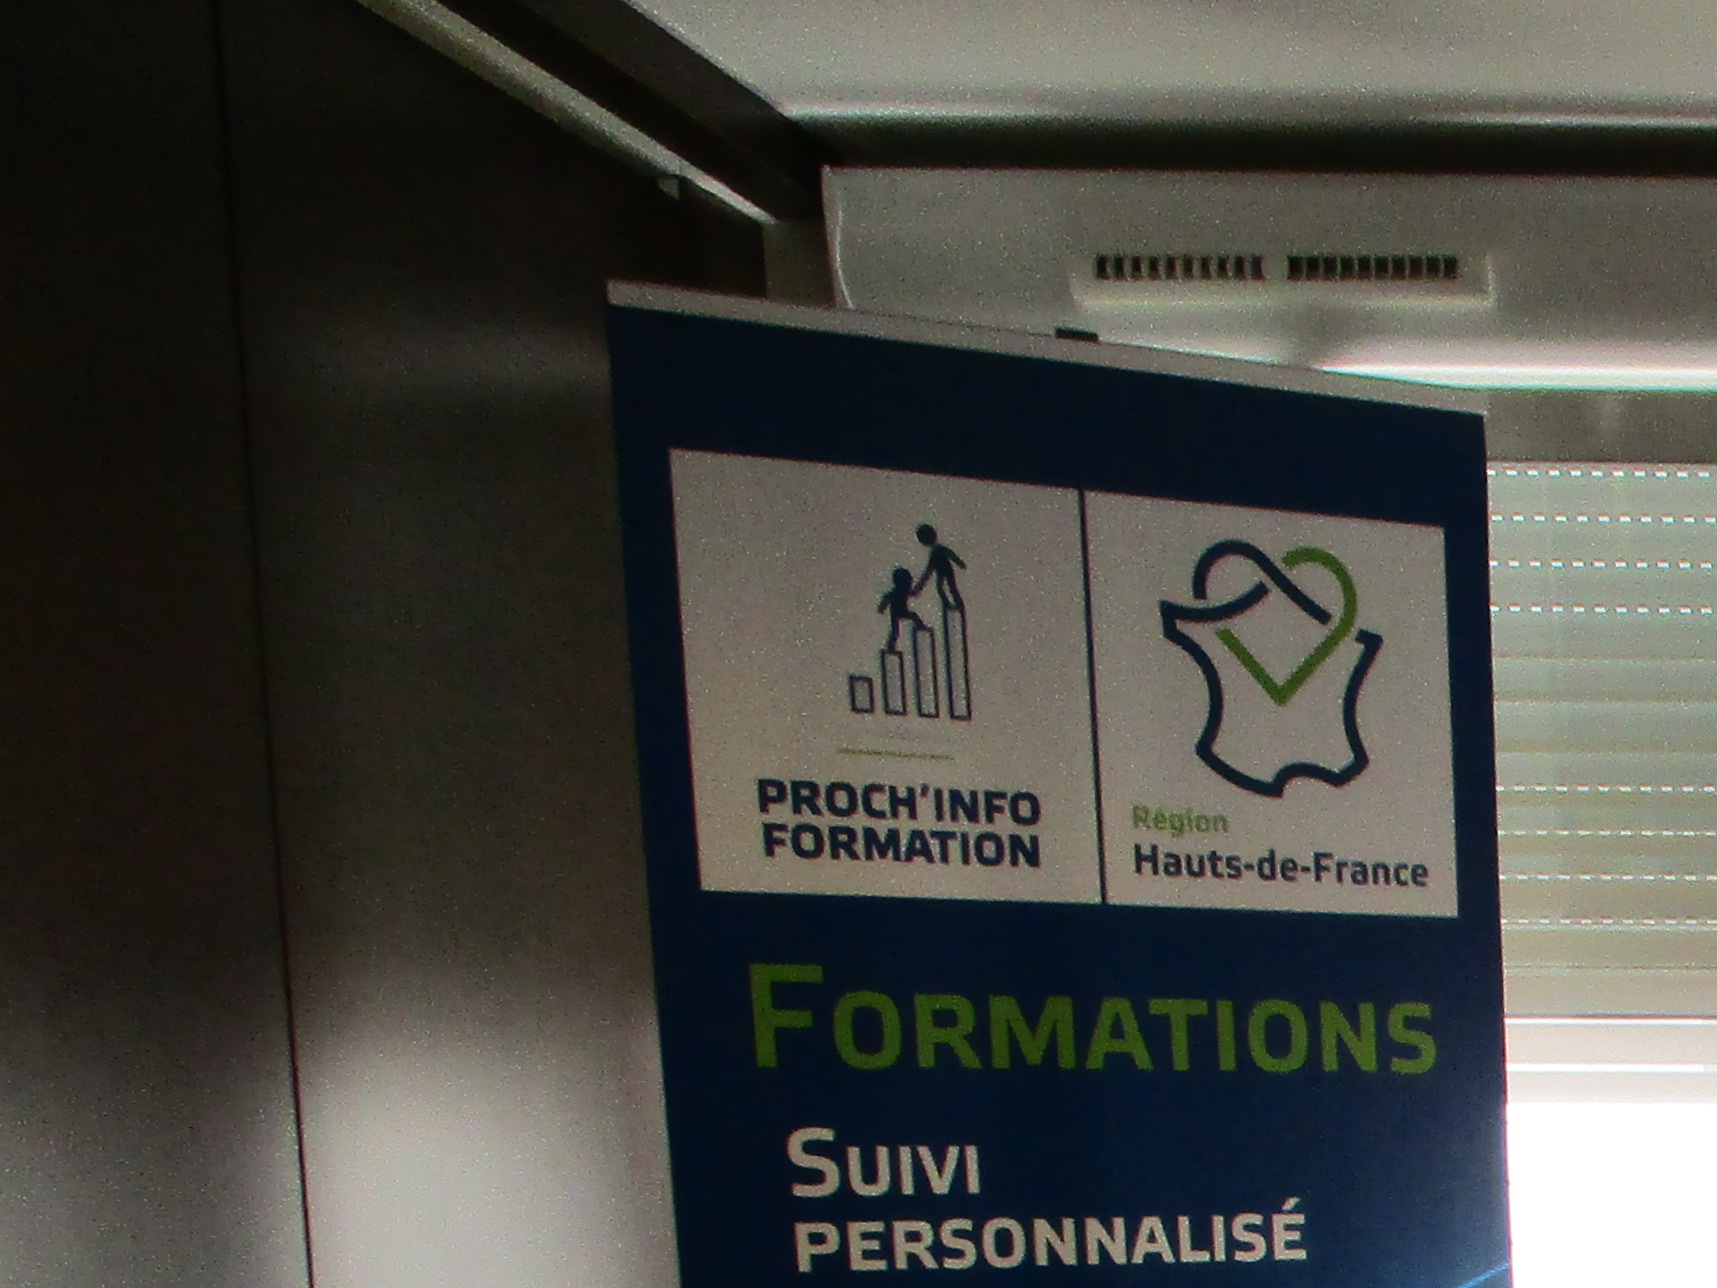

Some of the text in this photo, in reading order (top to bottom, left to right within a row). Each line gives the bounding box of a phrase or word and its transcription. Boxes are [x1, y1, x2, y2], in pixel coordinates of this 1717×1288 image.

[757, 777, 1042, 828] PROCH'INFO
[1132, 805, 1229, 838] Région
[762, 822, 1042, 868] FORMATION
[1133, 842, 1429, 887] Hauts-de-France
[748, 962, 1438, 1074] FORMATIONS
[786, 1126, 981, 1198] SUIVI
[795, 1197, 1307, 1273] PERSONNALISÉ
